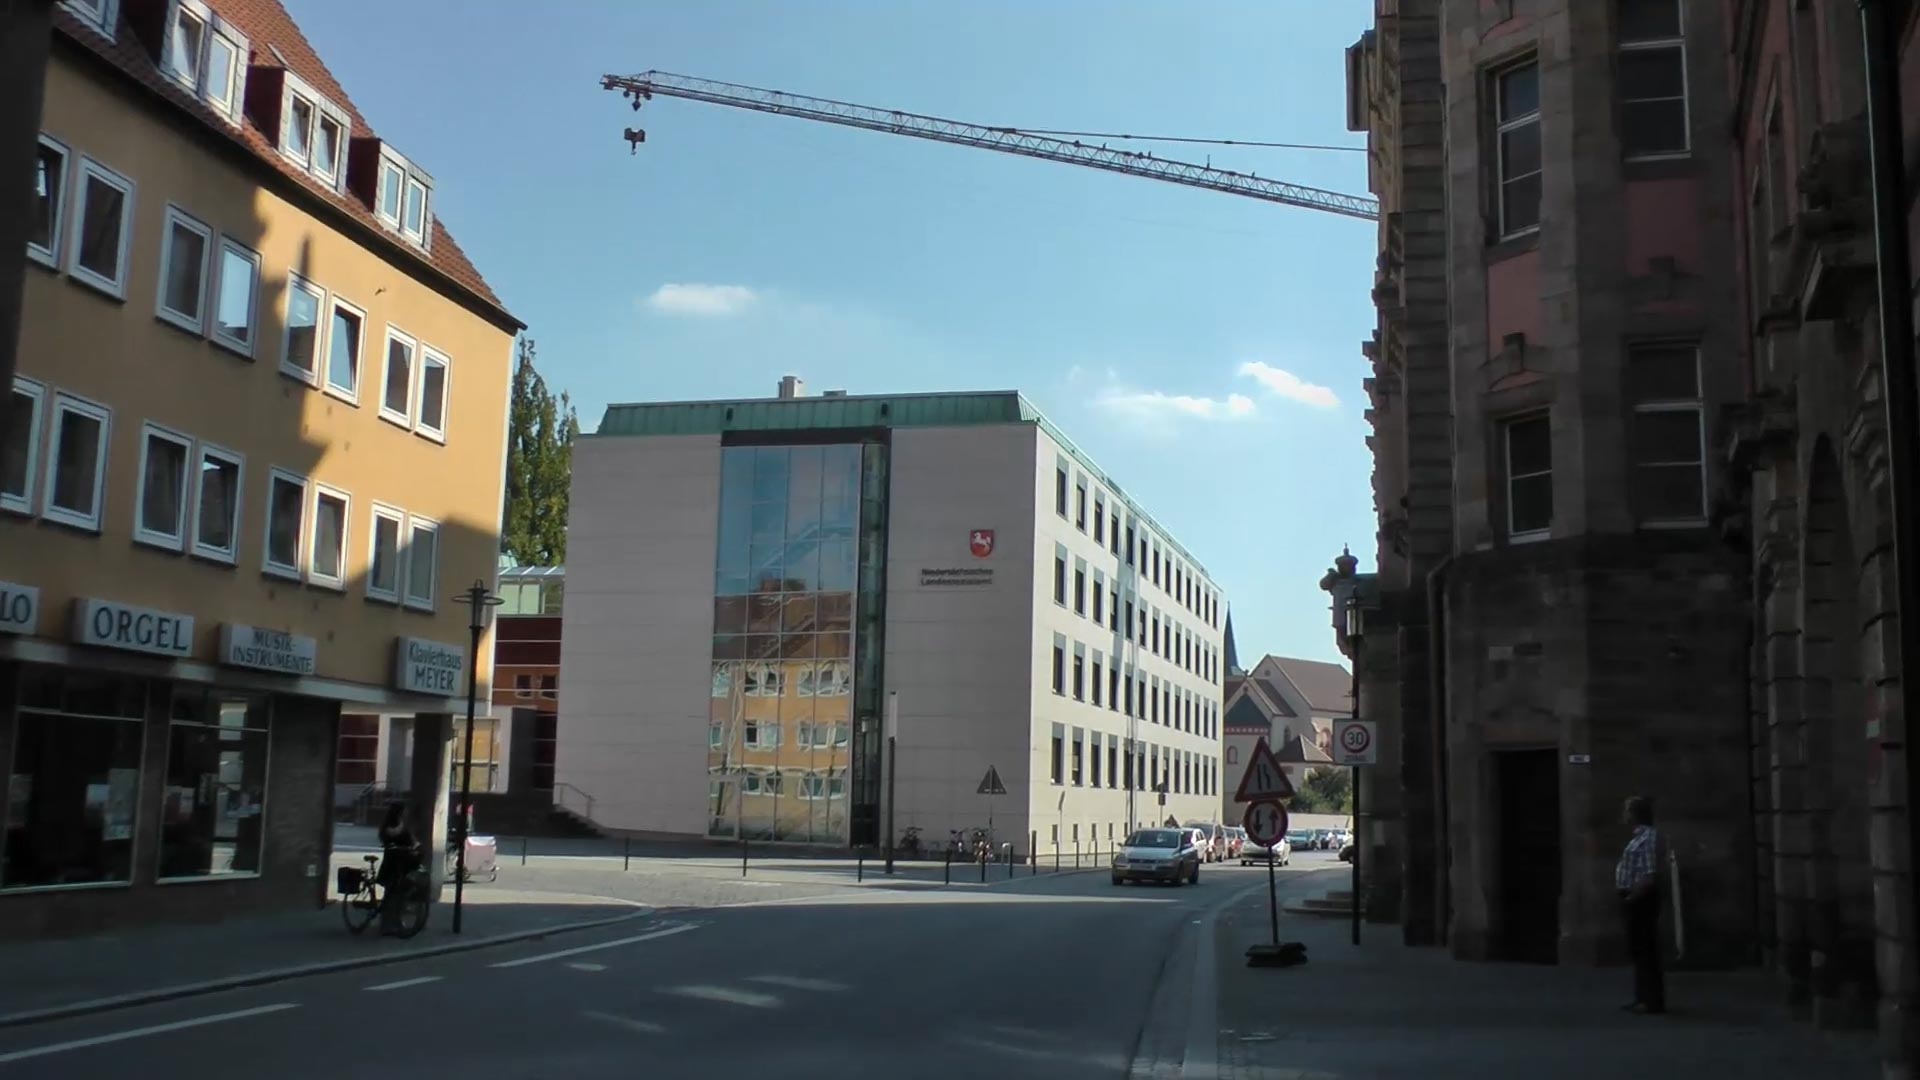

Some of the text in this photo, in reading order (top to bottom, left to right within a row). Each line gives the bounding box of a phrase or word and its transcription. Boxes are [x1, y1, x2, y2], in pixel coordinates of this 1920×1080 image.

[0, 591, 31, 624] LO
[94, 606, 188, 651] ORGEL
[253, 629, 297, 652] MUSIK-
[232, 645, 313, 673] INSTRUMENTE
[409, 641, 462, 670] Klavierhaus
[414, 665, 455, 691] MEYER
[1347, 731, 1365, 746] 30
